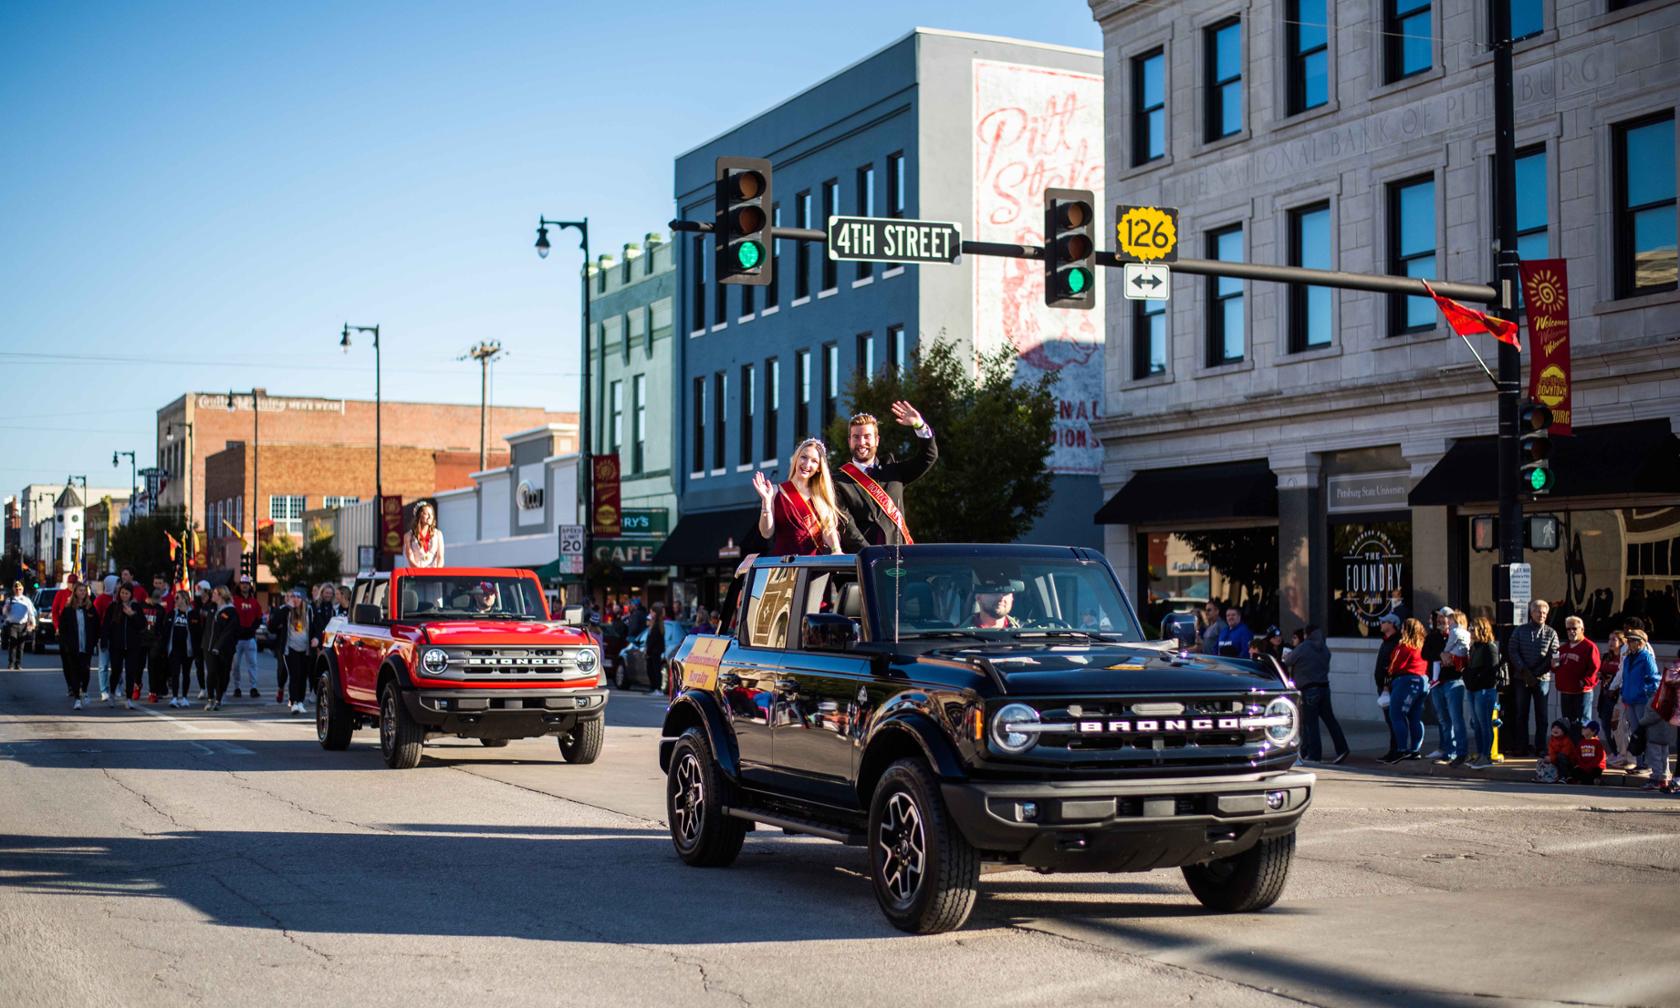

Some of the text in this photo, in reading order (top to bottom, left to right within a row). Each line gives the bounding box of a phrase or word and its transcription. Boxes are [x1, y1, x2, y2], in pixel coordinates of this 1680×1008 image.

[1330, 116, 1392, 157] BANK
[1401, 105, 1432, 134] OF
[1446, 53, 1599, 123] PITTBURG
[977, 91, 1087, 184] Pitt
[837, 223, 952, 258] 4TH STREET
[1126, 218, 1169, 249] 126
[562, 540, 582, 552] 20
[595, 546, 653, 562] CAFE
[1365, 552, 1381, 560] THE
[1346, 563, 1402, 592] FOUNDRY
[1080, 718, 1239, 732] BRONCO
